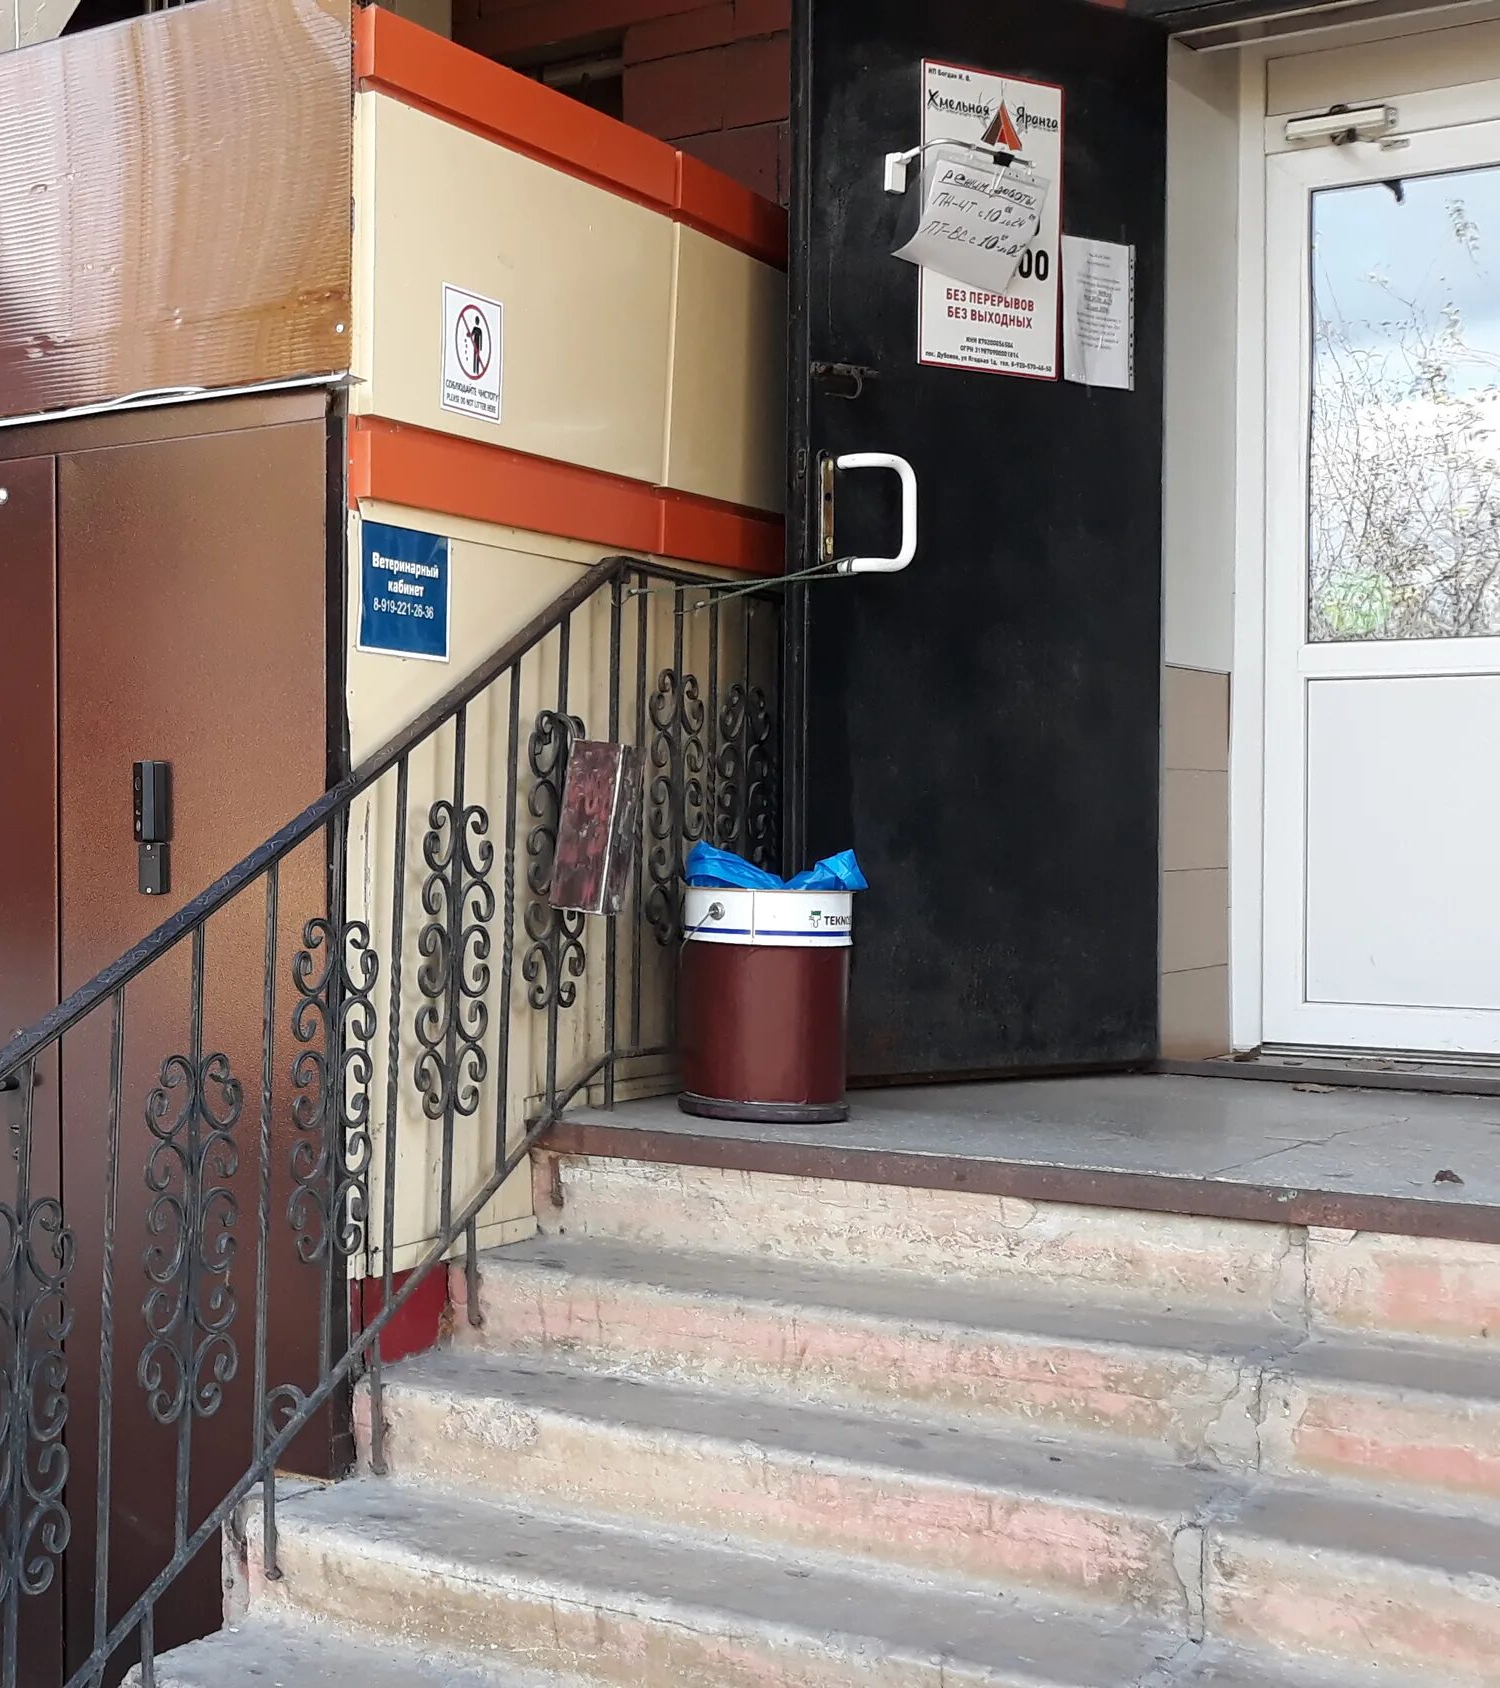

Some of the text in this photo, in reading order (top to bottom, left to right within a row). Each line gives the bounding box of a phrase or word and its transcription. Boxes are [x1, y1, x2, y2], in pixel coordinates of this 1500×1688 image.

[927, 88, 990, 116] Хмельная
[1016, 106, 1059, 129] Яранга
[946, 287, 1035, 312] БЕЗ ПЕРЕРЫВОВ
[947, 305, 1033, 330] БЕЗ ВЫХОДНЫХ
[372, 551, 439, 579] Ветеринарный
[387, 579, 424, 597] кабинет
[373, 597, 434, 620] 8-919-221-26-36
